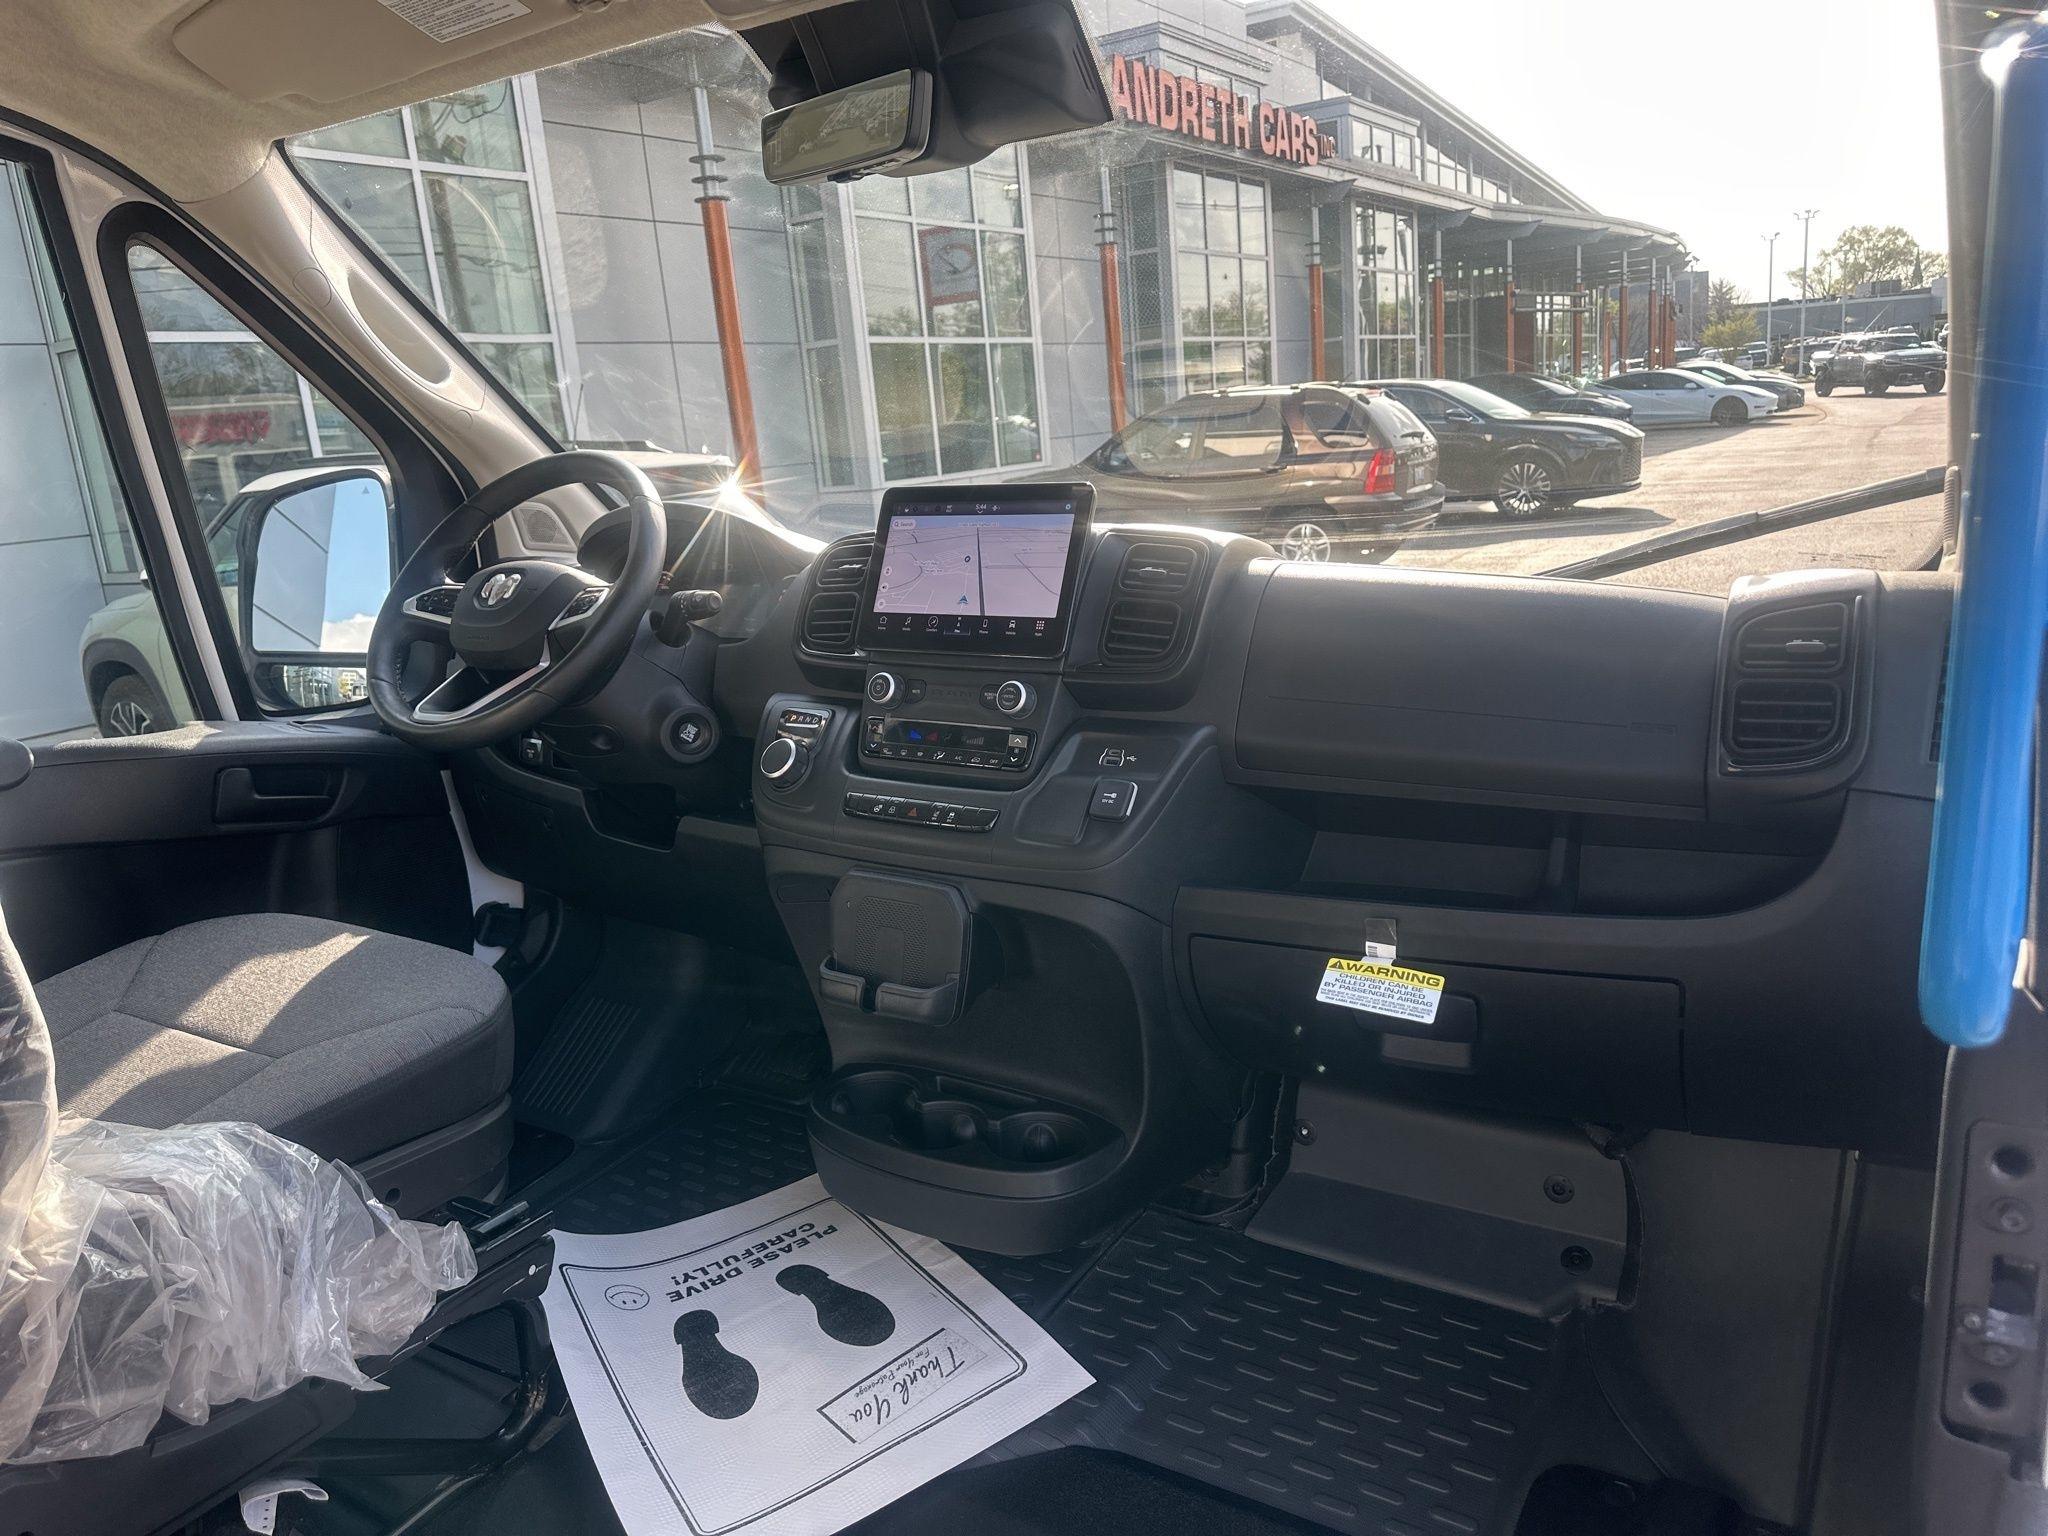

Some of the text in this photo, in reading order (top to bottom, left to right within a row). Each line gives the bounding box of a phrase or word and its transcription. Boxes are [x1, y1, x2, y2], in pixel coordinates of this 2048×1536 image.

[1112, 53, 1250, 150] ANDRETH
[1258, 102, 1319, 166] CARS
[1334, 977, 1365, 987] KILLED
[1368, 983, 1381, 991] OR
[1384, 986, 1426, 999] INJURED
[1339, 972, 1385, 985] CHILDREN
[1388, 981, 1409, 990] CAN
[1339, 984, 1394, 1000] PASSENGER
[1398, 996, 1433, 1008] AIRBAG
[1346, 962, 1441, 987] WARNING
[665, 1224, 839, 1302] PLEASE DRIVE
[670, 1222, 815, 1286] CAREFULLY!
[849, 1346, 965, 1425] Thank You
[854, 1347, 930, 1398] For Your Patronage
